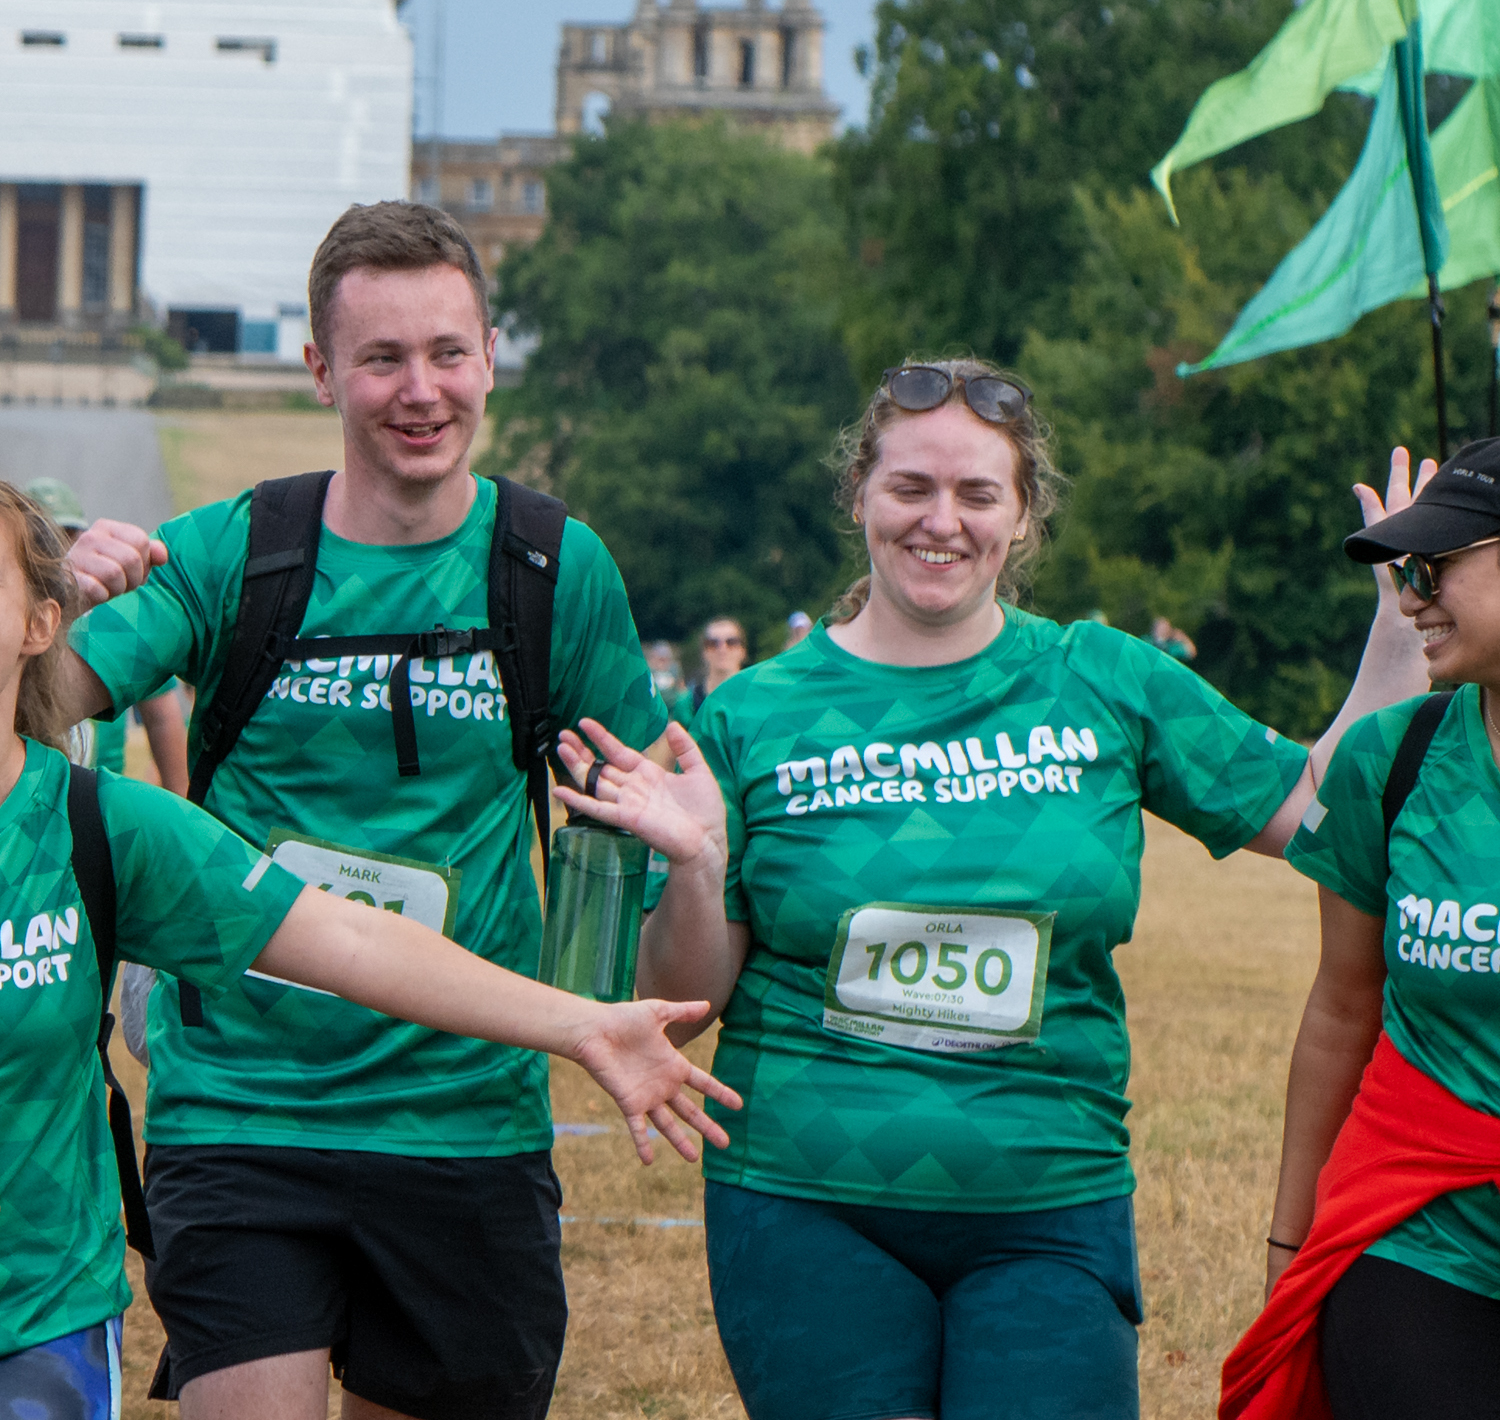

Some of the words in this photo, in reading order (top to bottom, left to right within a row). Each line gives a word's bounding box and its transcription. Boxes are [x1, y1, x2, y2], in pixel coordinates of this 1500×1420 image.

[267, 676, 352, 708] NCER
[775, 726, 1098, 795] MACMILLAN
[786, 779, 926, 815] CANCER
[934, 764, 1082, 803] SUPPORT
[339, 864, 382, 884] MARK
[925, 922, 963, 933] ORLA
[865, 940, 1012, 996] 1050
[902, 988, 964, 1004] Wave:07:30
[892, 1003, 934, 1020] Mighty
[937, 1011, 970, 1022] Hikes
